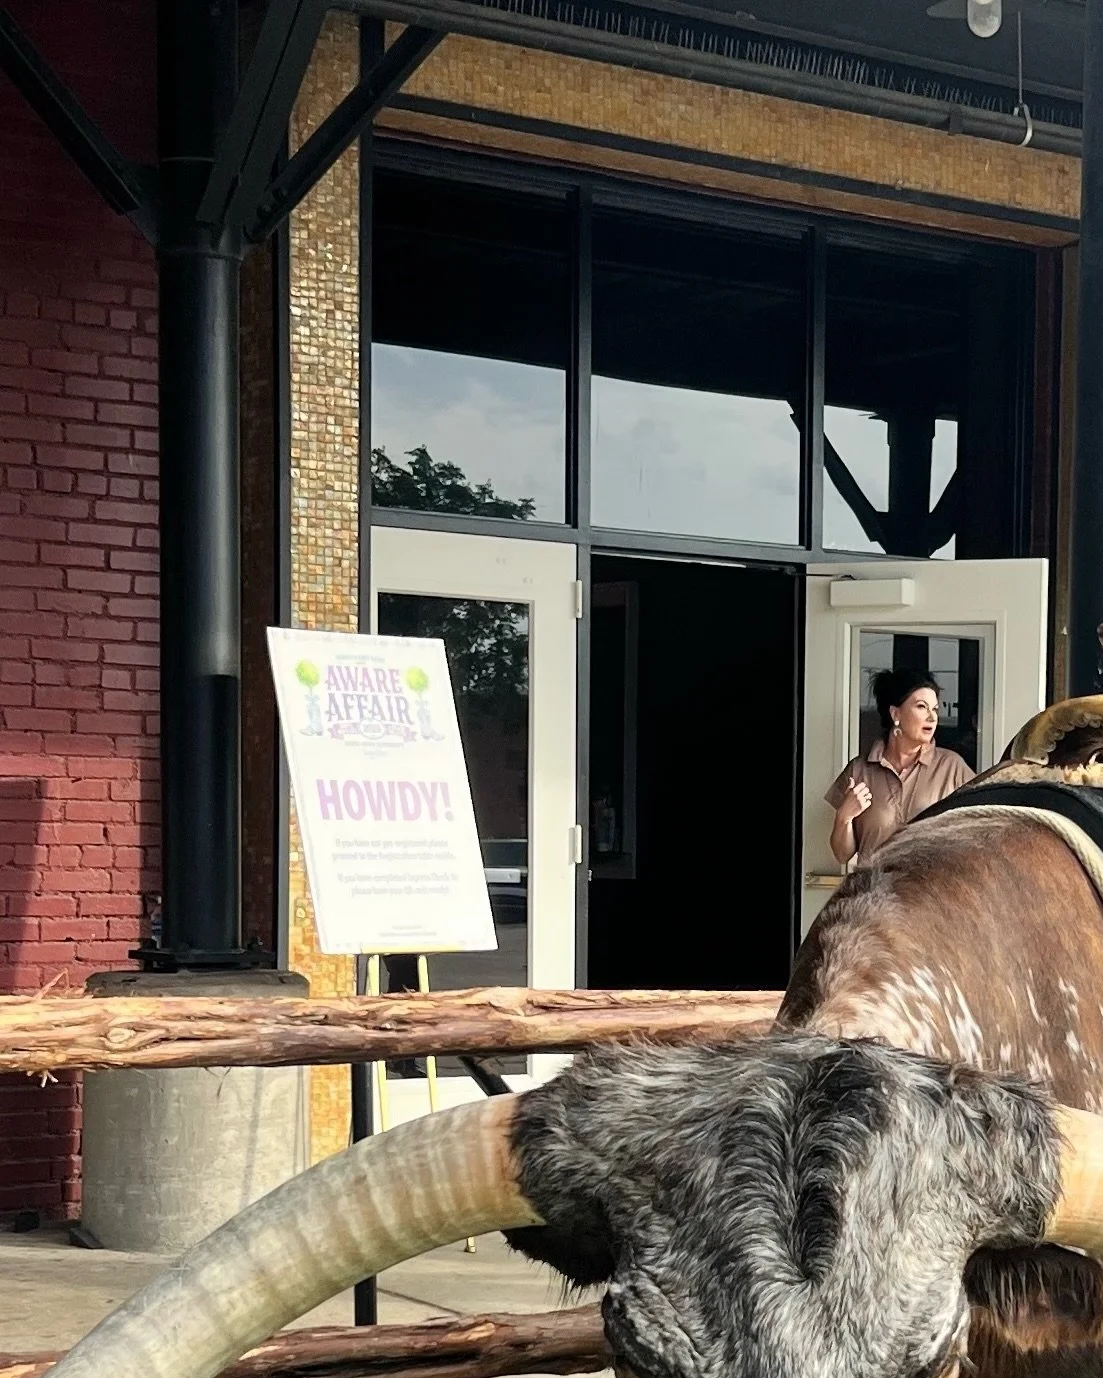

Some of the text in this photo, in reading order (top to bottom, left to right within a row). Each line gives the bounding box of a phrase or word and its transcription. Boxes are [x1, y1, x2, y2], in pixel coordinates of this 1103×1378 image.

[326, 664, 404, 694] AWARE
[325, 692, 415, 725] AFFAIR
[316, 778, 454, 822] HOWDY!
